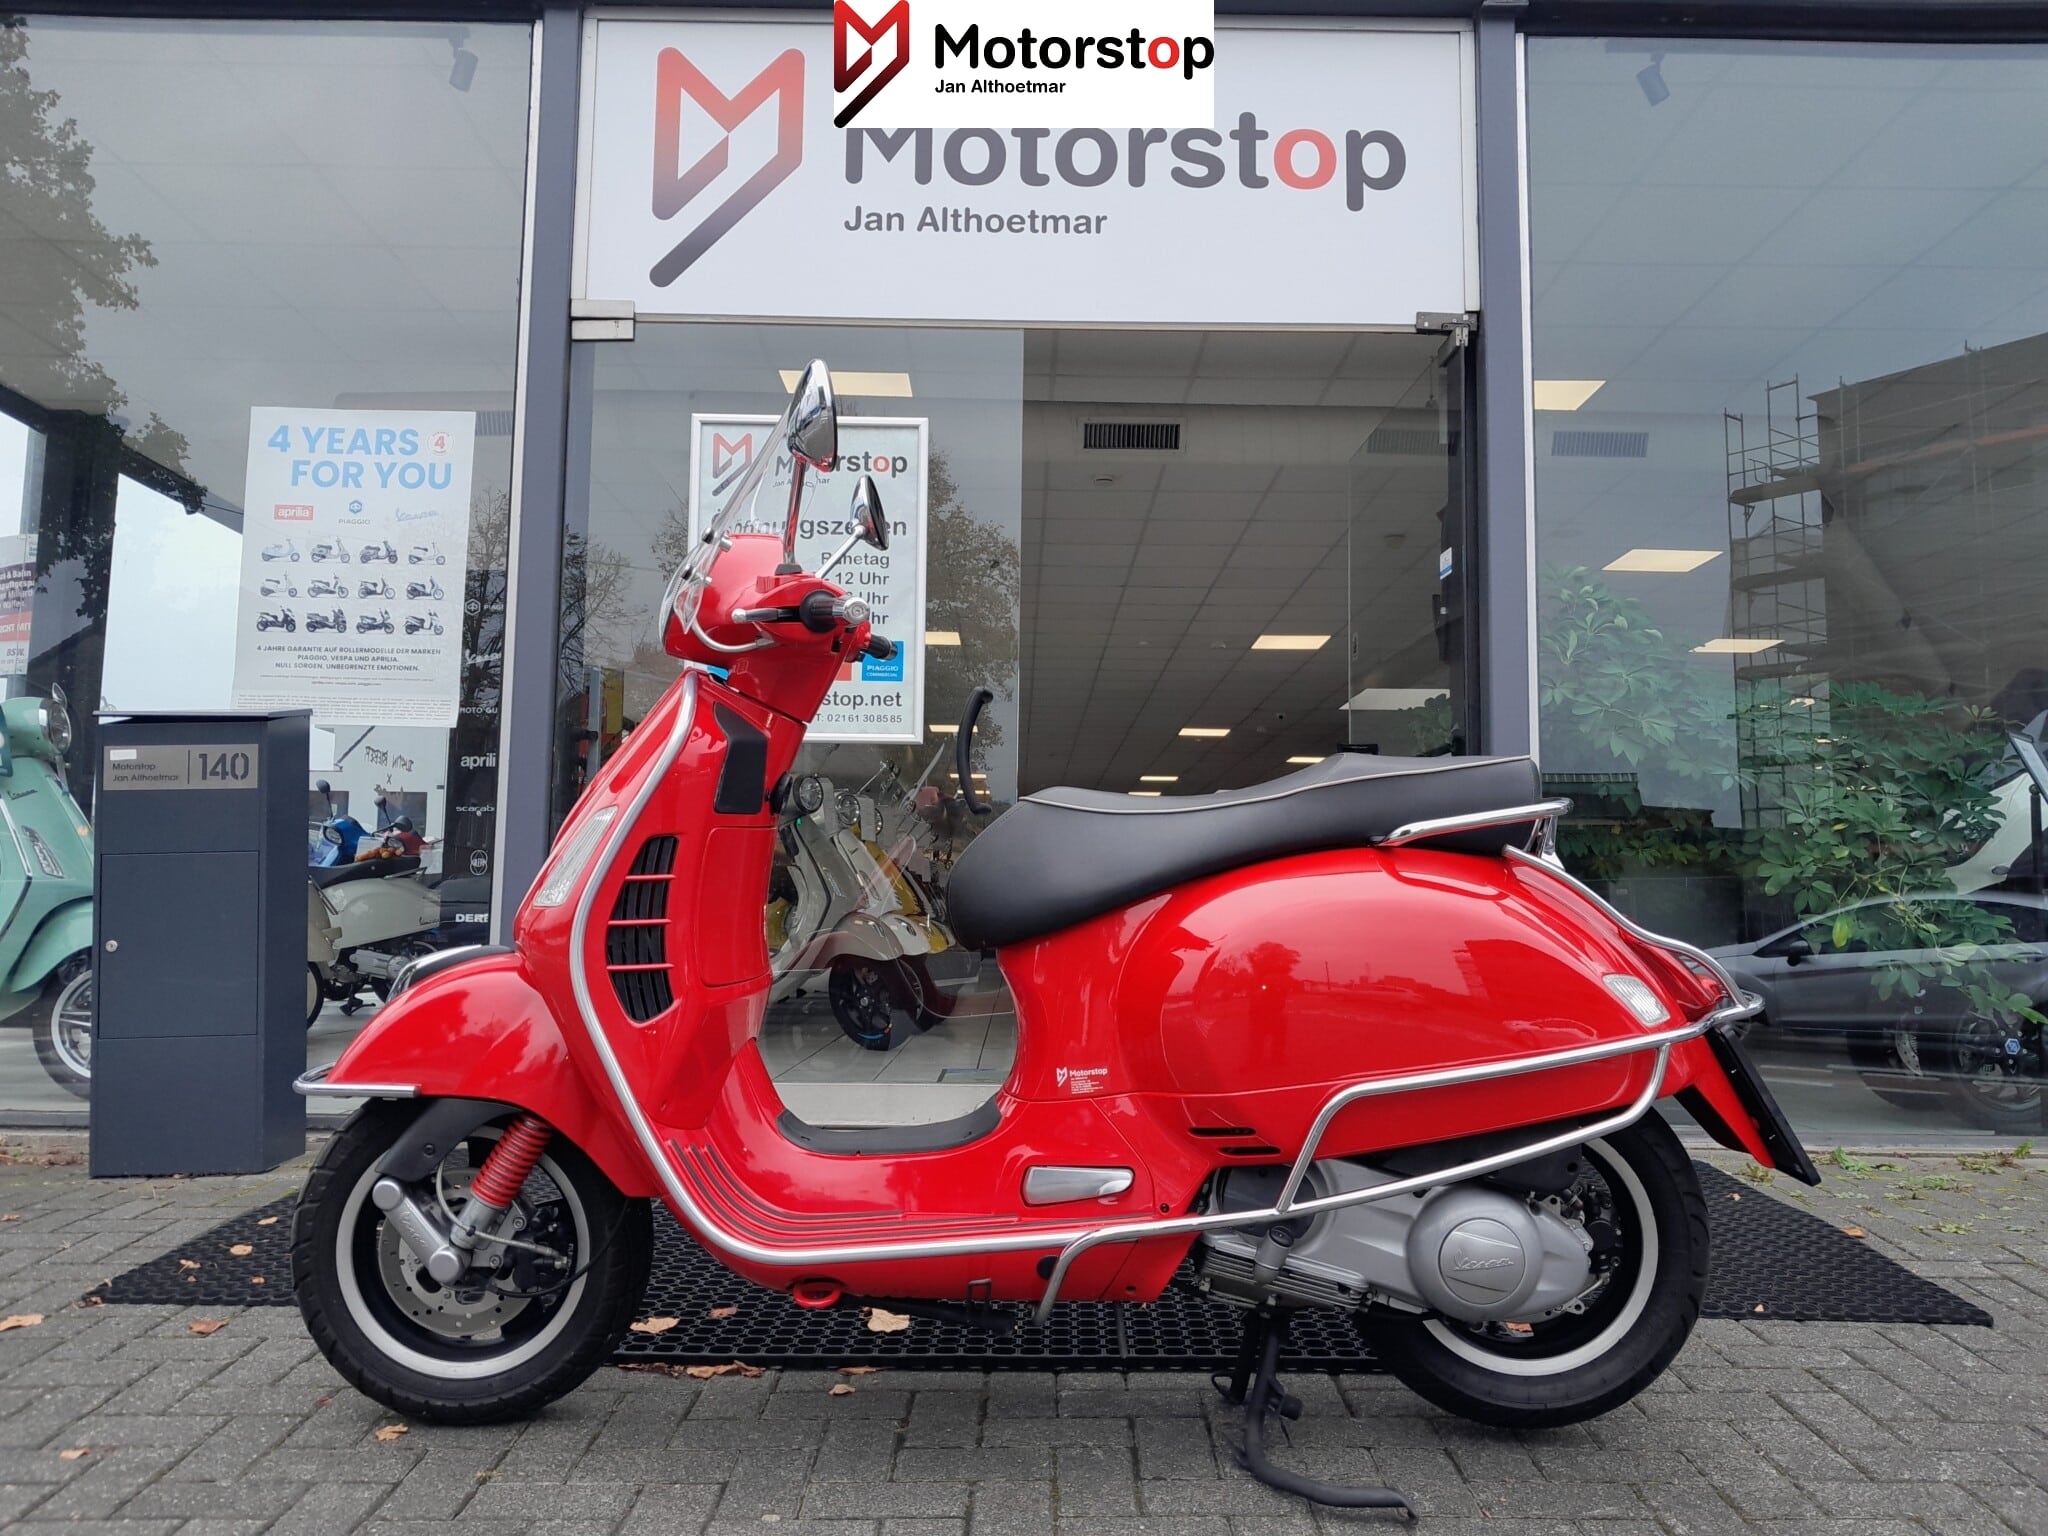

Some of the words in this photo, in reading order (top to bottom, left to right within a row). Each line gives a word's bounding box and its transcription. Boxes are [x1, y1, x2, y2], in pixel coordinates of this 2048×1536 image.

[845, 111, 1407, 212] Motorstop
[843, 206, 905, 232] Jan
[917, 206, 1108, 235] Althoetmar
[267, 425, 291, 453] 4
[302, 427, 420, 456] YEARS
[775, 451, 908, 478] Mrstop
[291, 460, 365, 489] FOR
[374, 462, 453, 490] YOU
[277, 505, 311, 518] aprilia
[821, 552, 890, 569] Rhetag
[835, 571, 854, 585] 12
[859, 571, 890, 585] Uhr
[871, 611, 889, 625] hr
[325, 663, 375, 671] UNBEGRENZTE
[460, 706, 483, 714] MOTO
[112, 763, 156, 771] Motorstop
[199, 752, 250, 781] 140
[130, 774, 179, 782] Althoetmar
[1069, 1067, 1109, 1078] Motorstop
